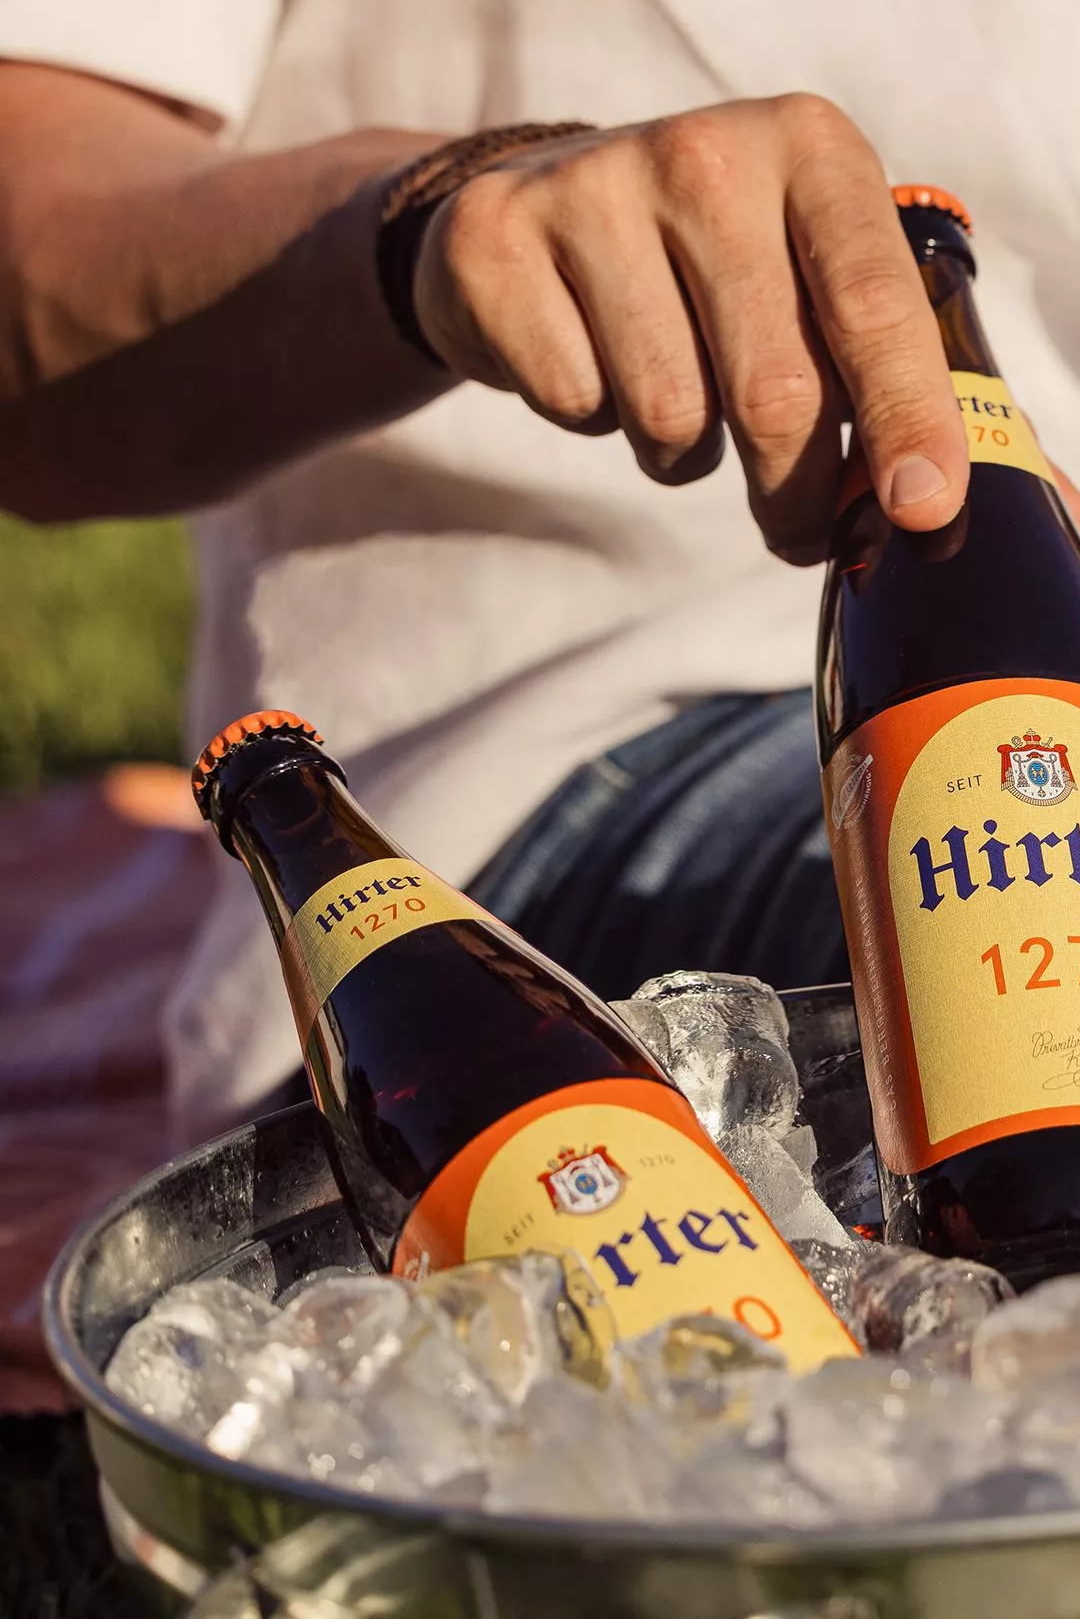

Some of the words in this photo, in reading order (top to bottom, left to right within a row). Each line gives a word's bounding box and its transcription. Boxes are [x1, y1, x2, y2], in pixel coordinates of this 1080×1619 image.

[955, 395, 1013, 419] rter
[971, 425, 1010, 448] 70
[946, 774, 982, 794] SEIT
[314, 872, 422, 935] Hirter
[349, 897, 427, 941] 1270
[594, 1207, 761, 1288] rter
